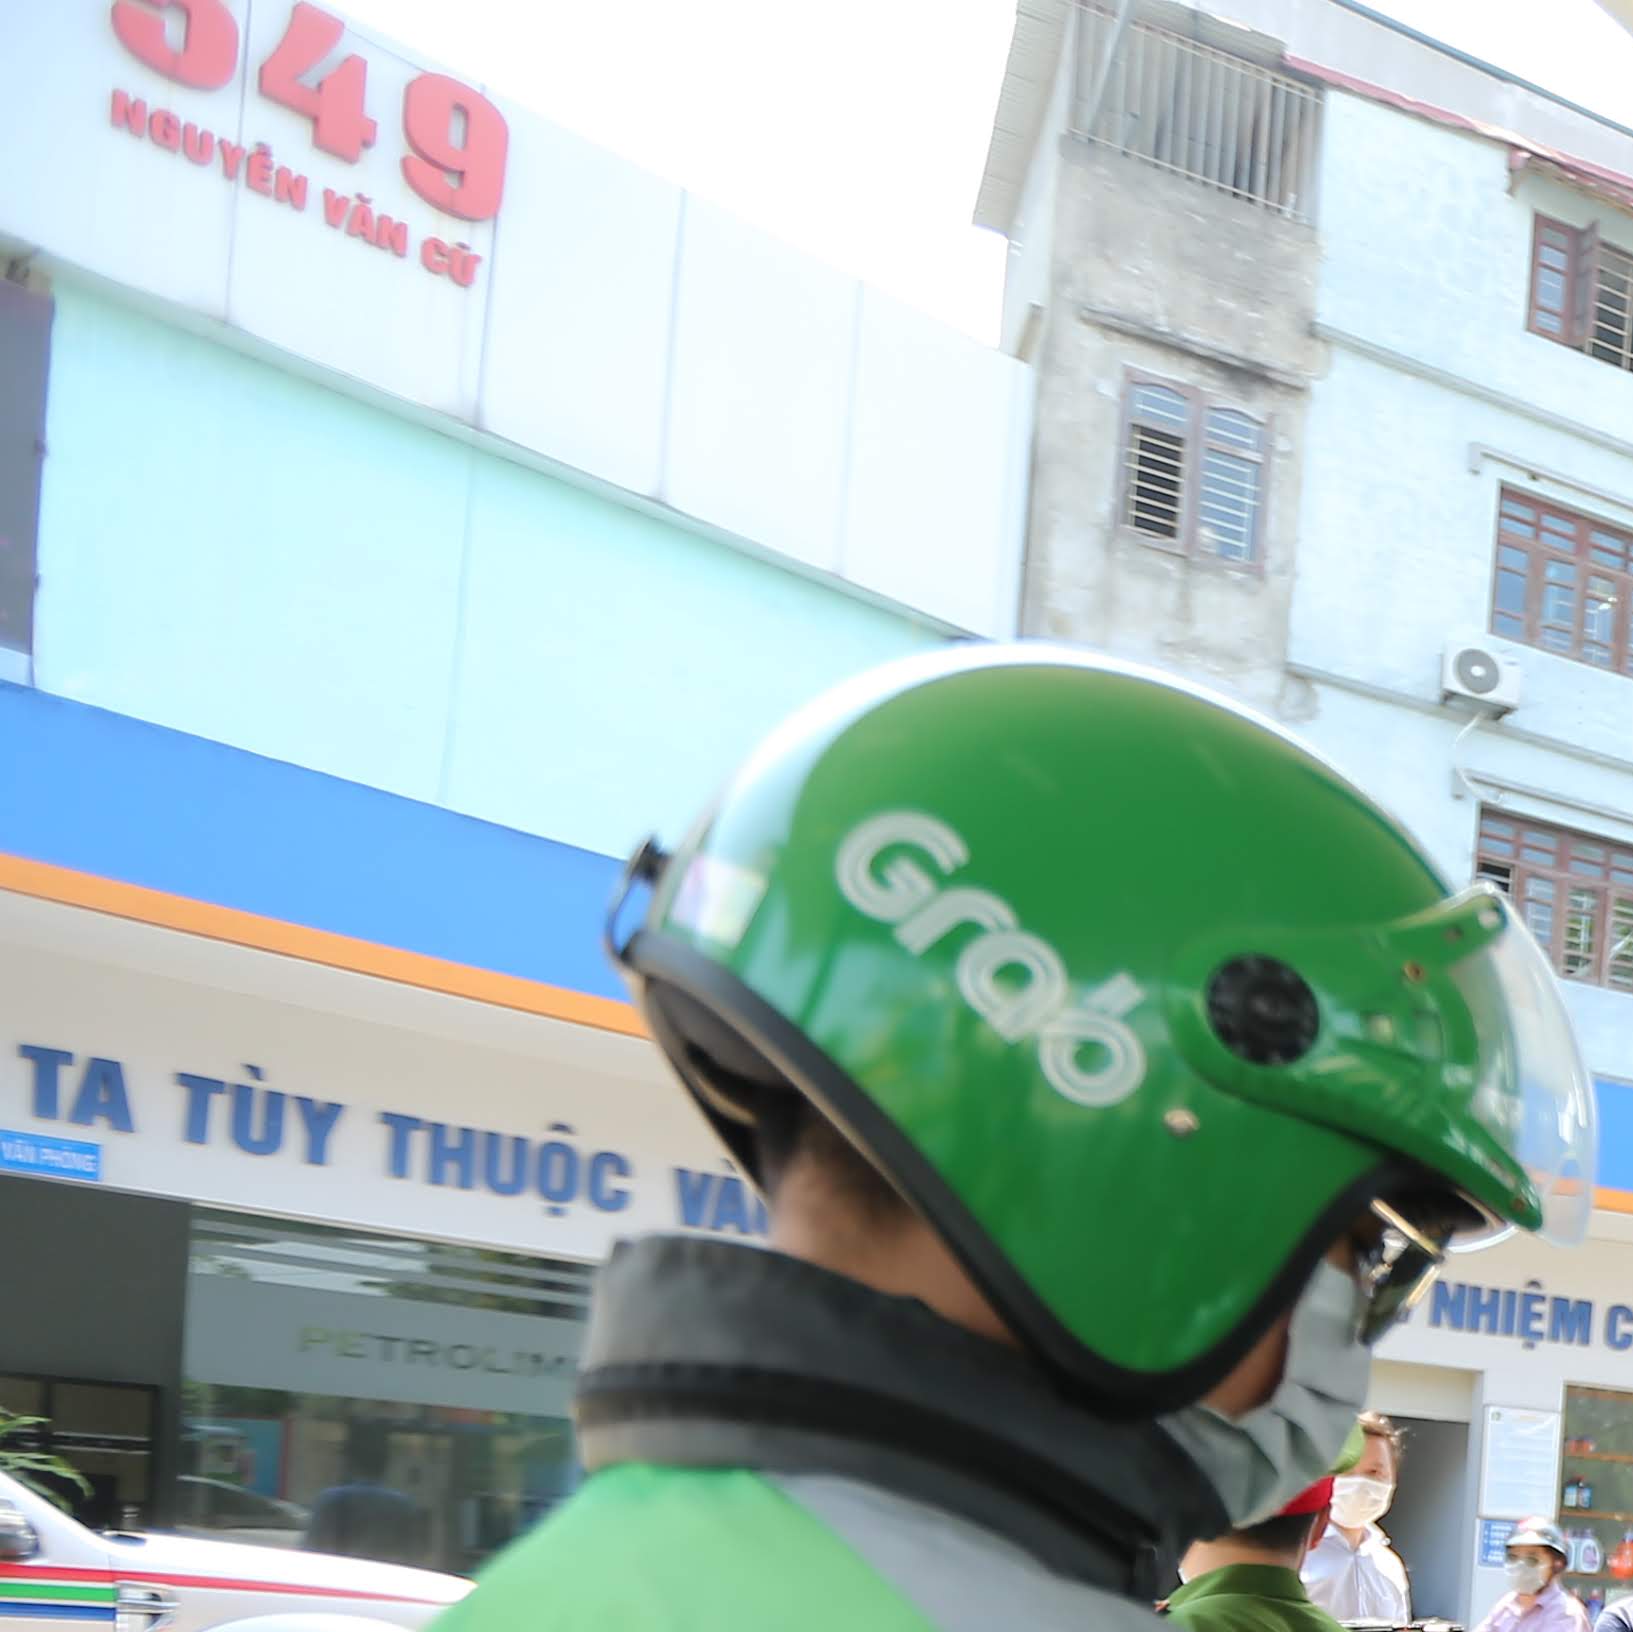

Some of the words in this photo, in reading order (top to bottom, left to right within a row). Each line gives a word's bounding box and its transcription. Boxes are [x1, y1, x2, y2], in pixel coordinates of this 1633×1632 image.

[835, 810, 1147, 1108] Grab
[19, 1044, 134, 1133] TA
[173, 1063, 346, 1166] TÙY
[377, 1110, 632, 1217] THUỘC
[673, 1157, 769, 1235] VÀ
[1429, 1280, 1592, 1349] NHIỆM
